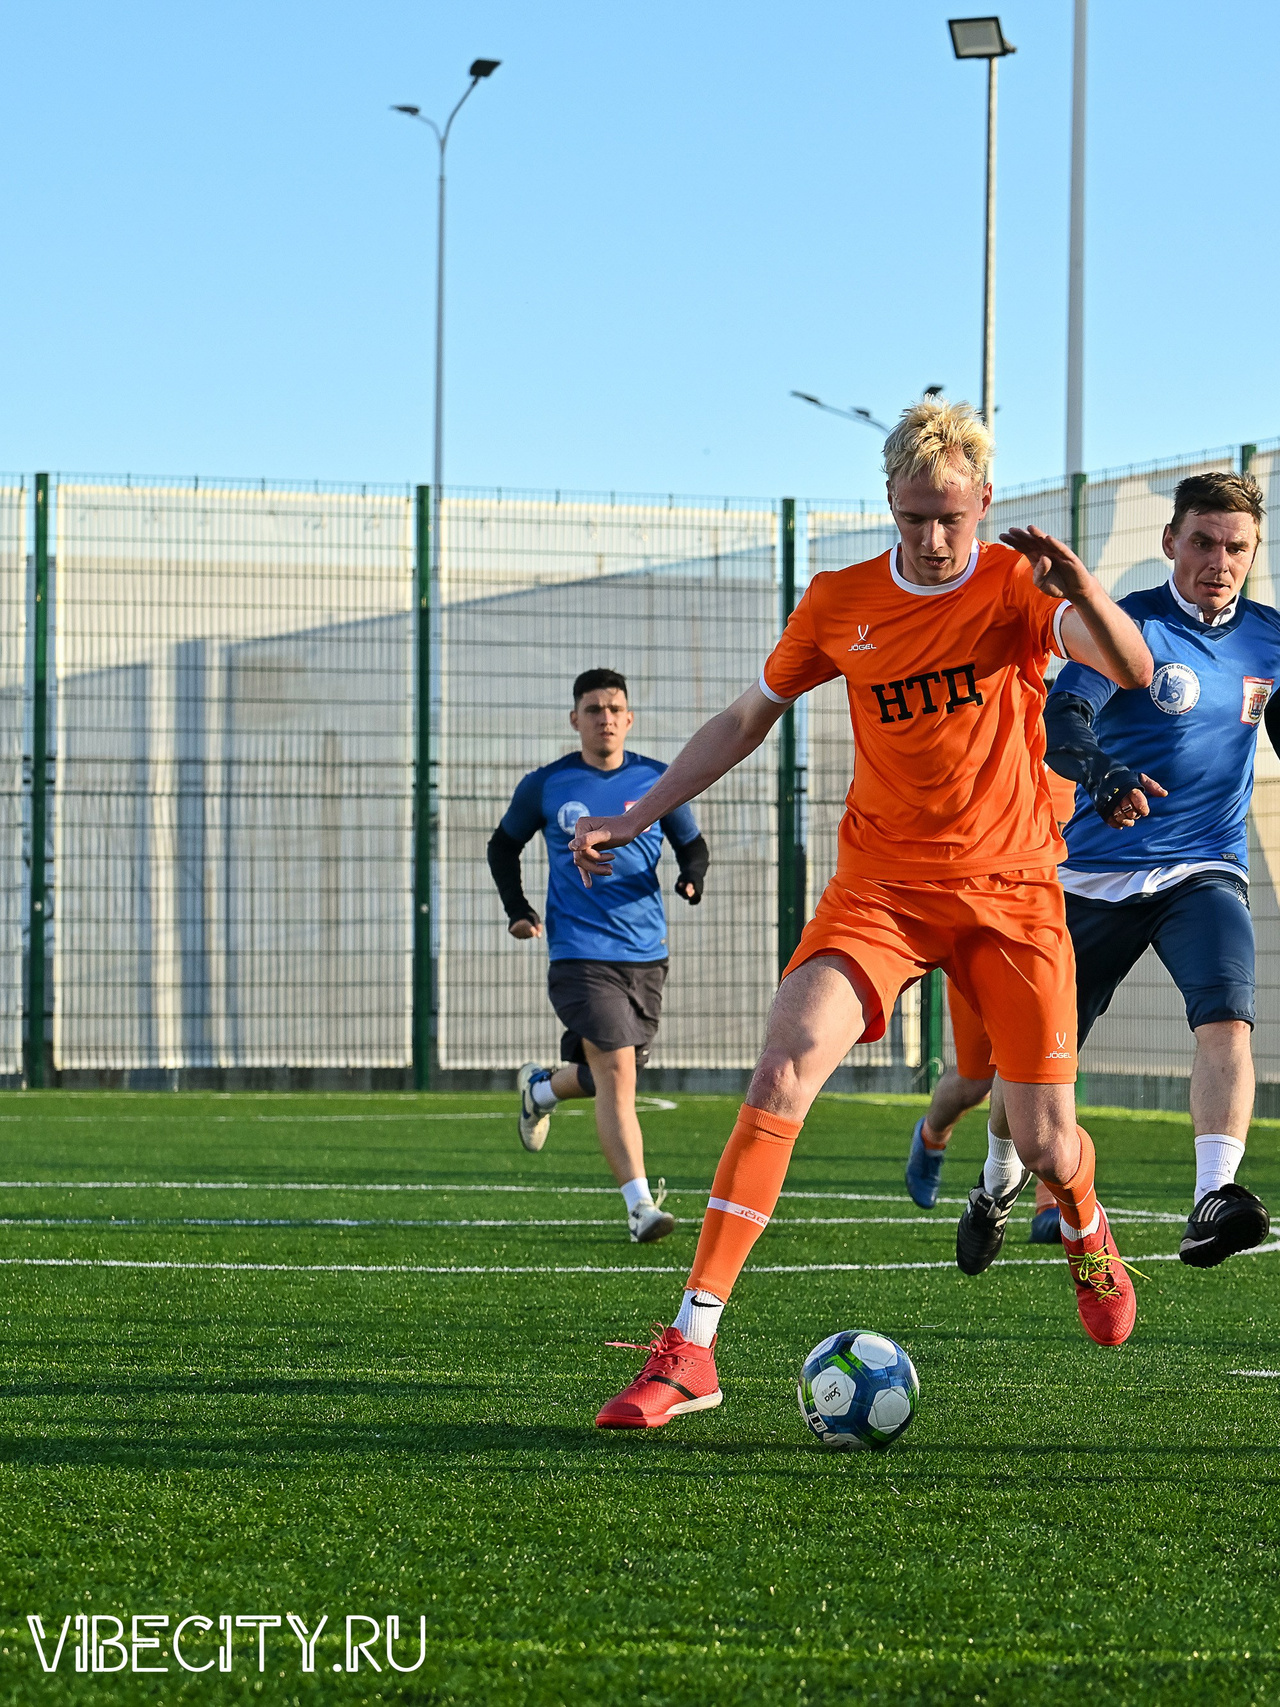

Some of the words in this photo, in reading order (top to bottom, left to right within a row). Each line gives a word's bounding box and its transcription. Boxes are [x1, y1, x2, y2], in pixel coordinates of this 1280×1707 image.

[847, 643, 877, 651] JÖGEL
[871, 663, 983, 723] НТД
[1045, 1051, 1073, 1059] JÖGEL
